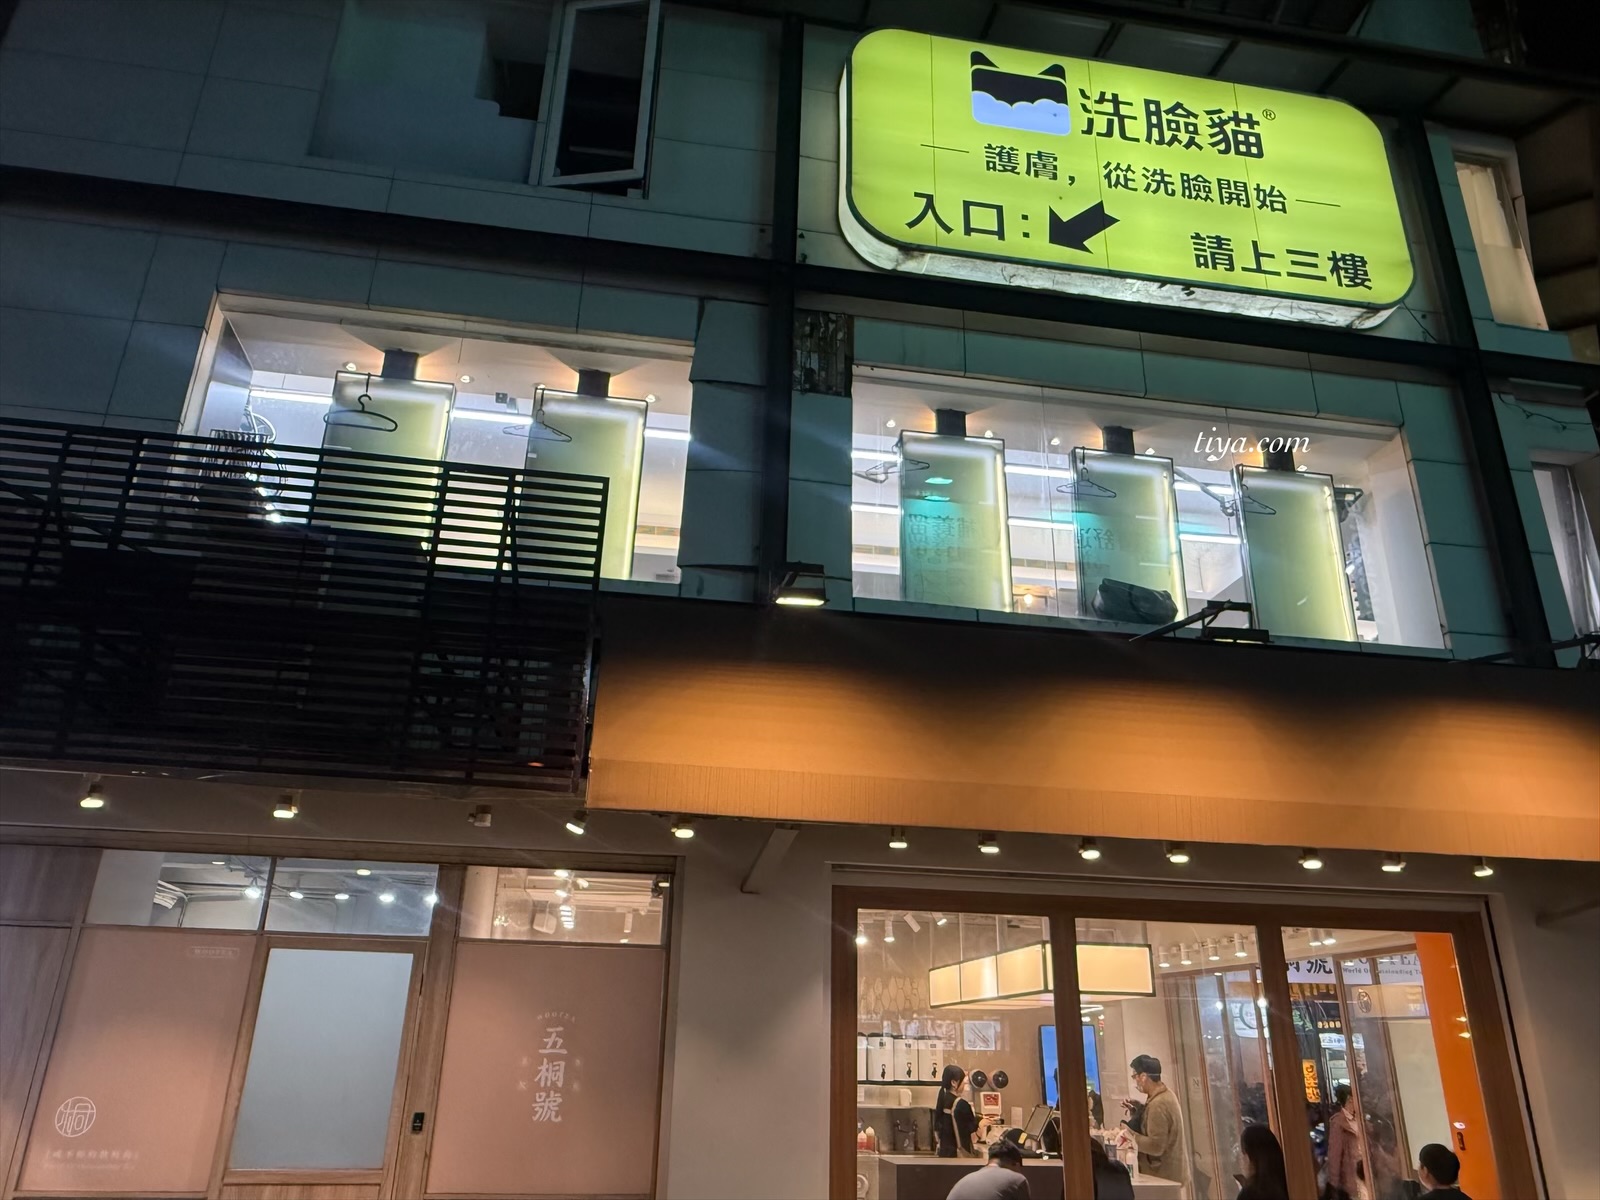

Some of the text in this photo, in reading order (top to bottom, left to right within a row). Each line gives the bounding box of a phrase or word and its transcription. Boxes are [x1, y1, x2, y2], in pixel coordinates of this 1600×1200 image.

[1190, 232, 1373, 291] 請上三樓
[532, 1026, 568, 1122] 五桐號
